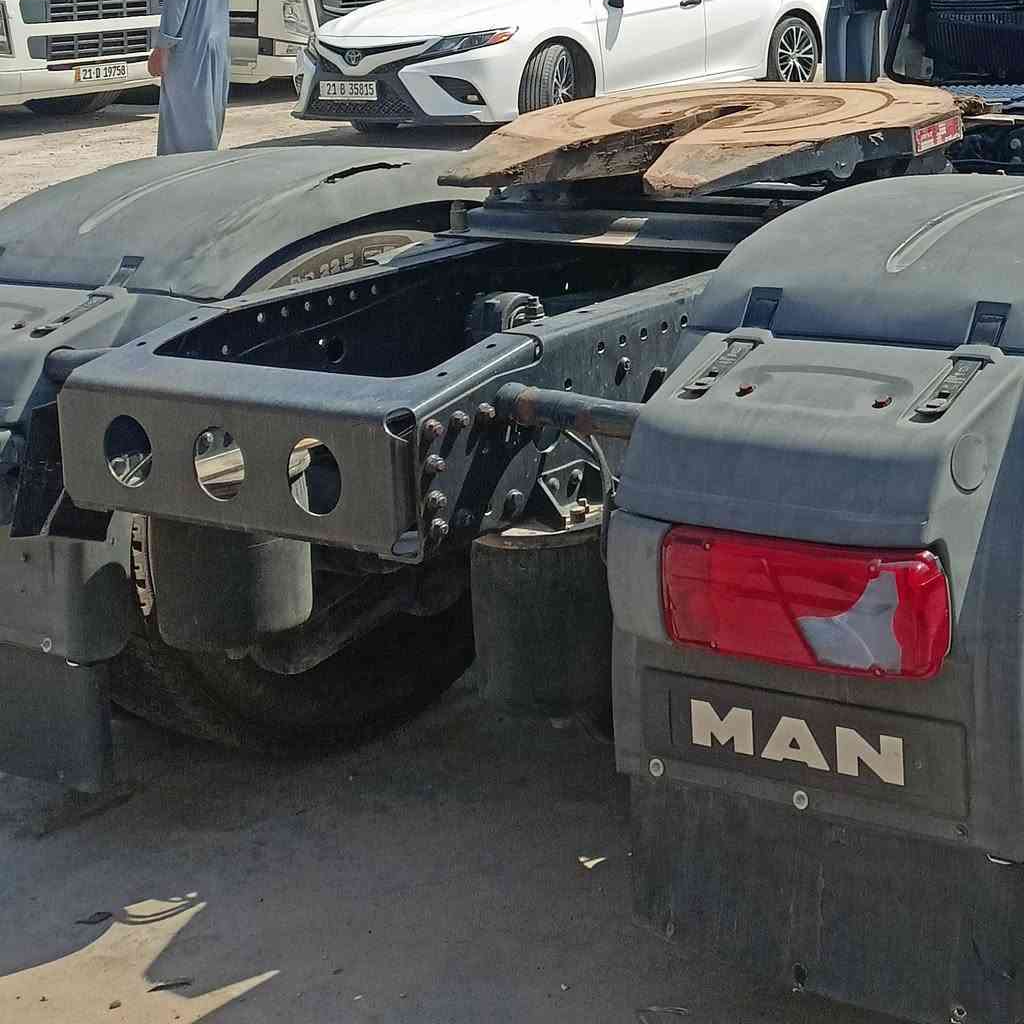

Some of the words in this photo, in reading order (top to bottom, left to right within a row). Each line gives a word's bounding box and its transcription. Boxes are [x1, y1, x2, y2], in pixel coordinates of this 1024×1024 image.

[326, 83, 336, 95] 21
[349, 83, 374, 96] 35815
[690, 698, 905, 786] MAN
